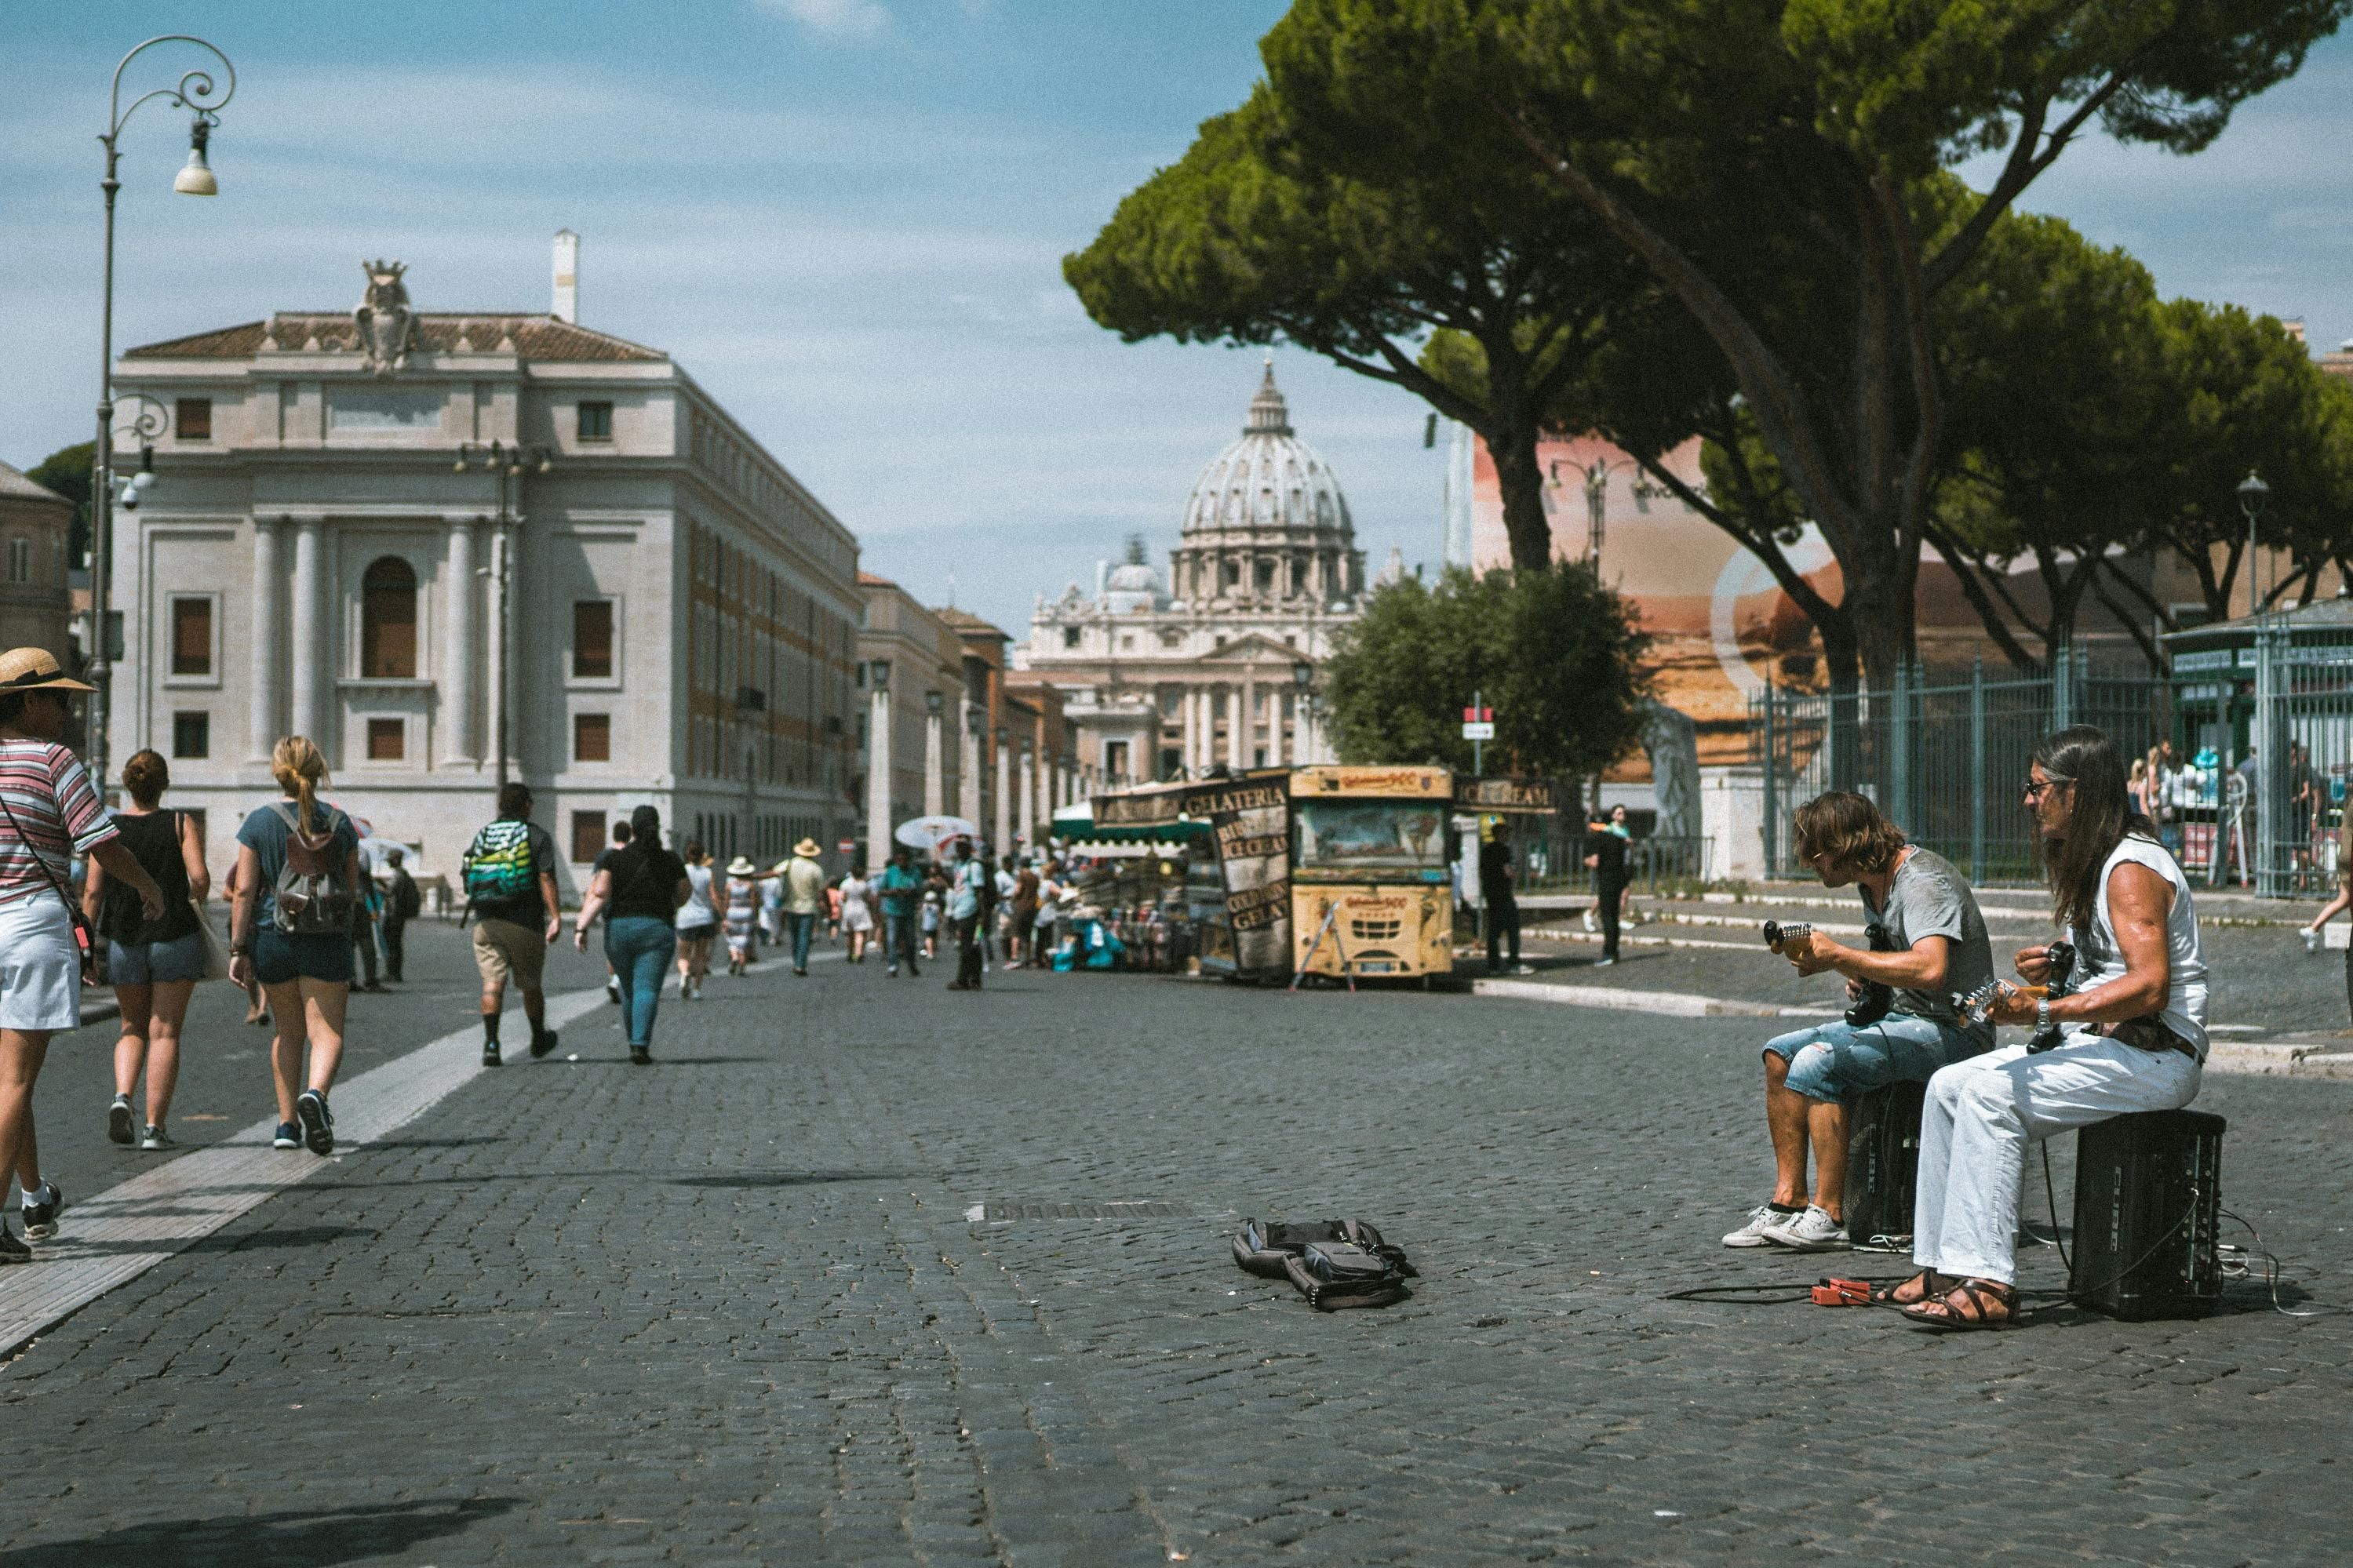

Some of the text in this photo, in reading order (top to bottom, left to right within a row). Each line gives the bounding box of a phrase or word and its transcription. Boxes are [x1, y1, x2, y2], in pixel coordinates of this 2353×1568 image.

[1186, 784, 1286, 816] GELATERIA
[1488, 784, 1550, 805] CREAM
[1868, 1123, 1877, 1193] CUBE
[2110, 1166, 2122, 1253] CUBE
